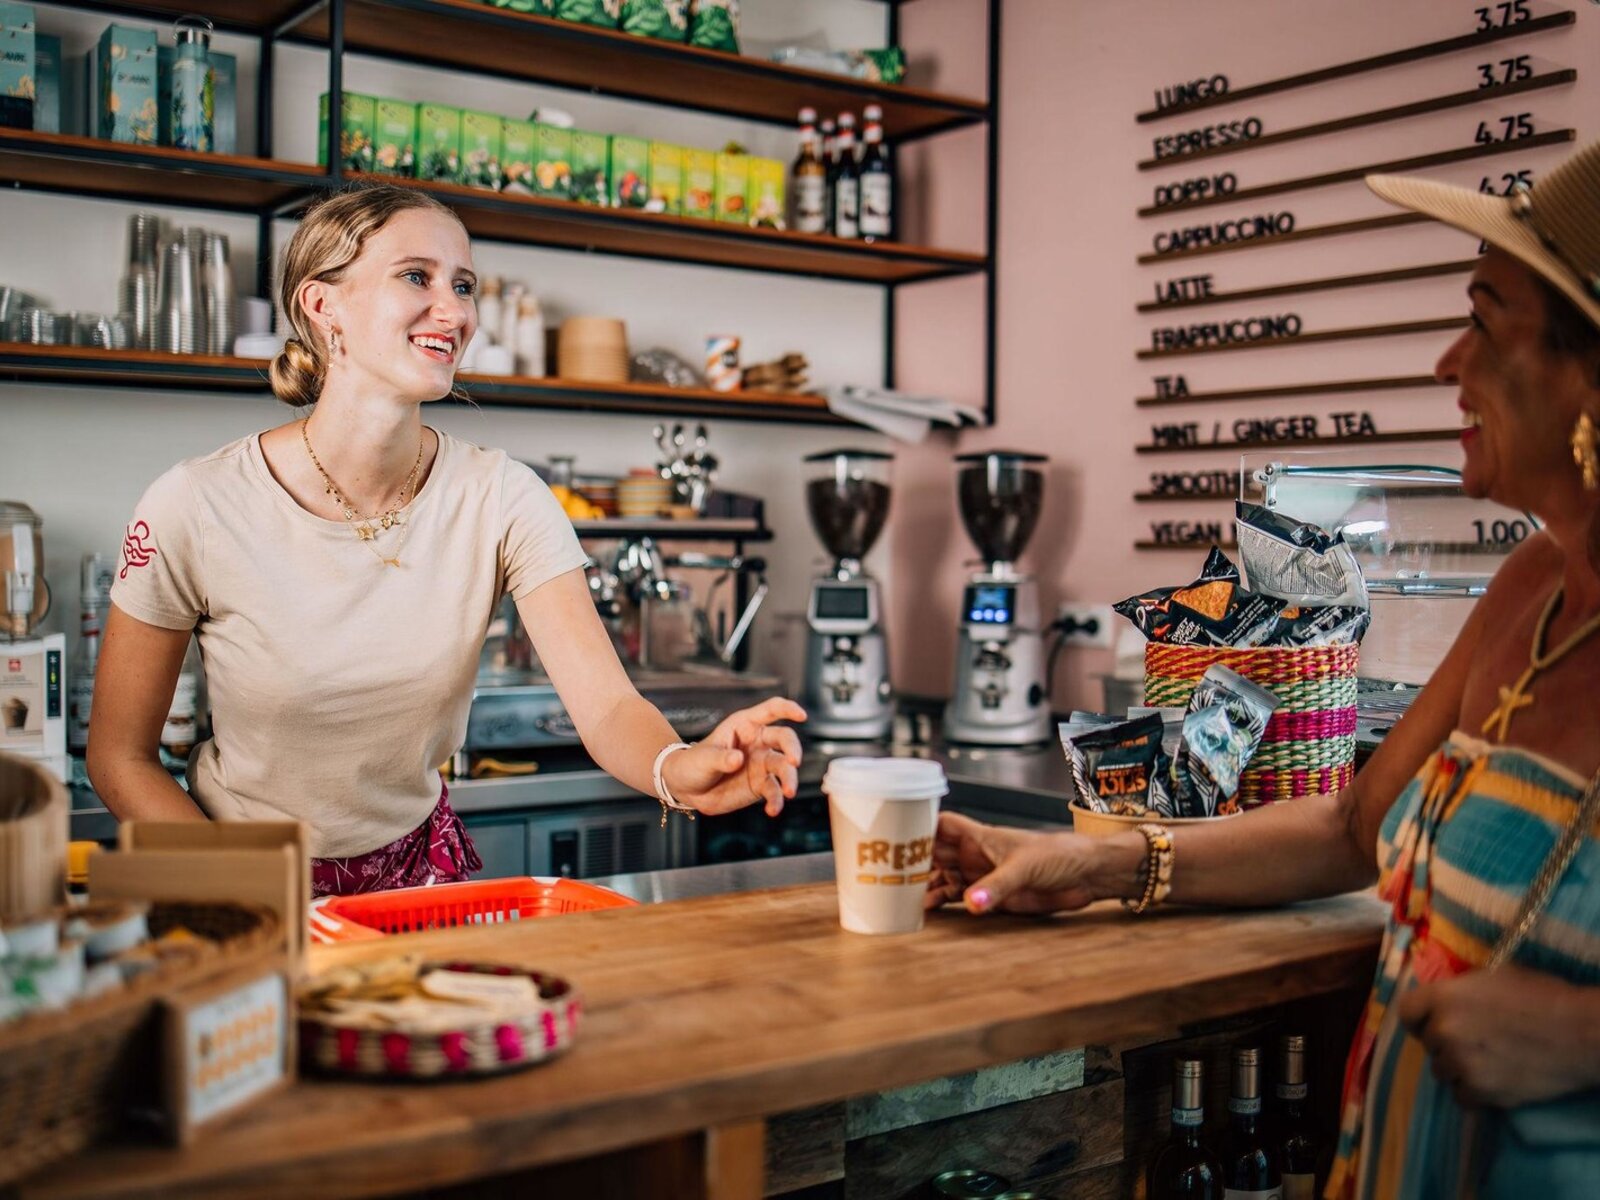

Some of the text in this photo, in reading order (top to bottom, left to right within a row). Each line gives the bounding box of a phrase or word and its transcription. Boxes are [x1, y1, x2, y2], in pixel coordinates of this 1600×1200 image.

[1154, 0, 1531, 110] LUNGO 3.75
[1153, 55, 1532, 159] ESPRESSO 3.75
[1154, 113, 1533, 207] DOPPIO 4.75
[1153, 170, 1533, 254] CAPPUCCINO 425
[1154, 273, 1214, 303] LATTE
[1151, 313, 1302, 350] FRAPPUCCINO
[1153, 375, 1190, 399] TEA
[1151, 422, 1199, 446] MINT
[1232, 415, 1318, 443] GINGER
[1329, 411, 1376, 438] TEA
[1151, 522, 1221, 545] VEGAN
[1472, 519, 1528, 545] 1.00
